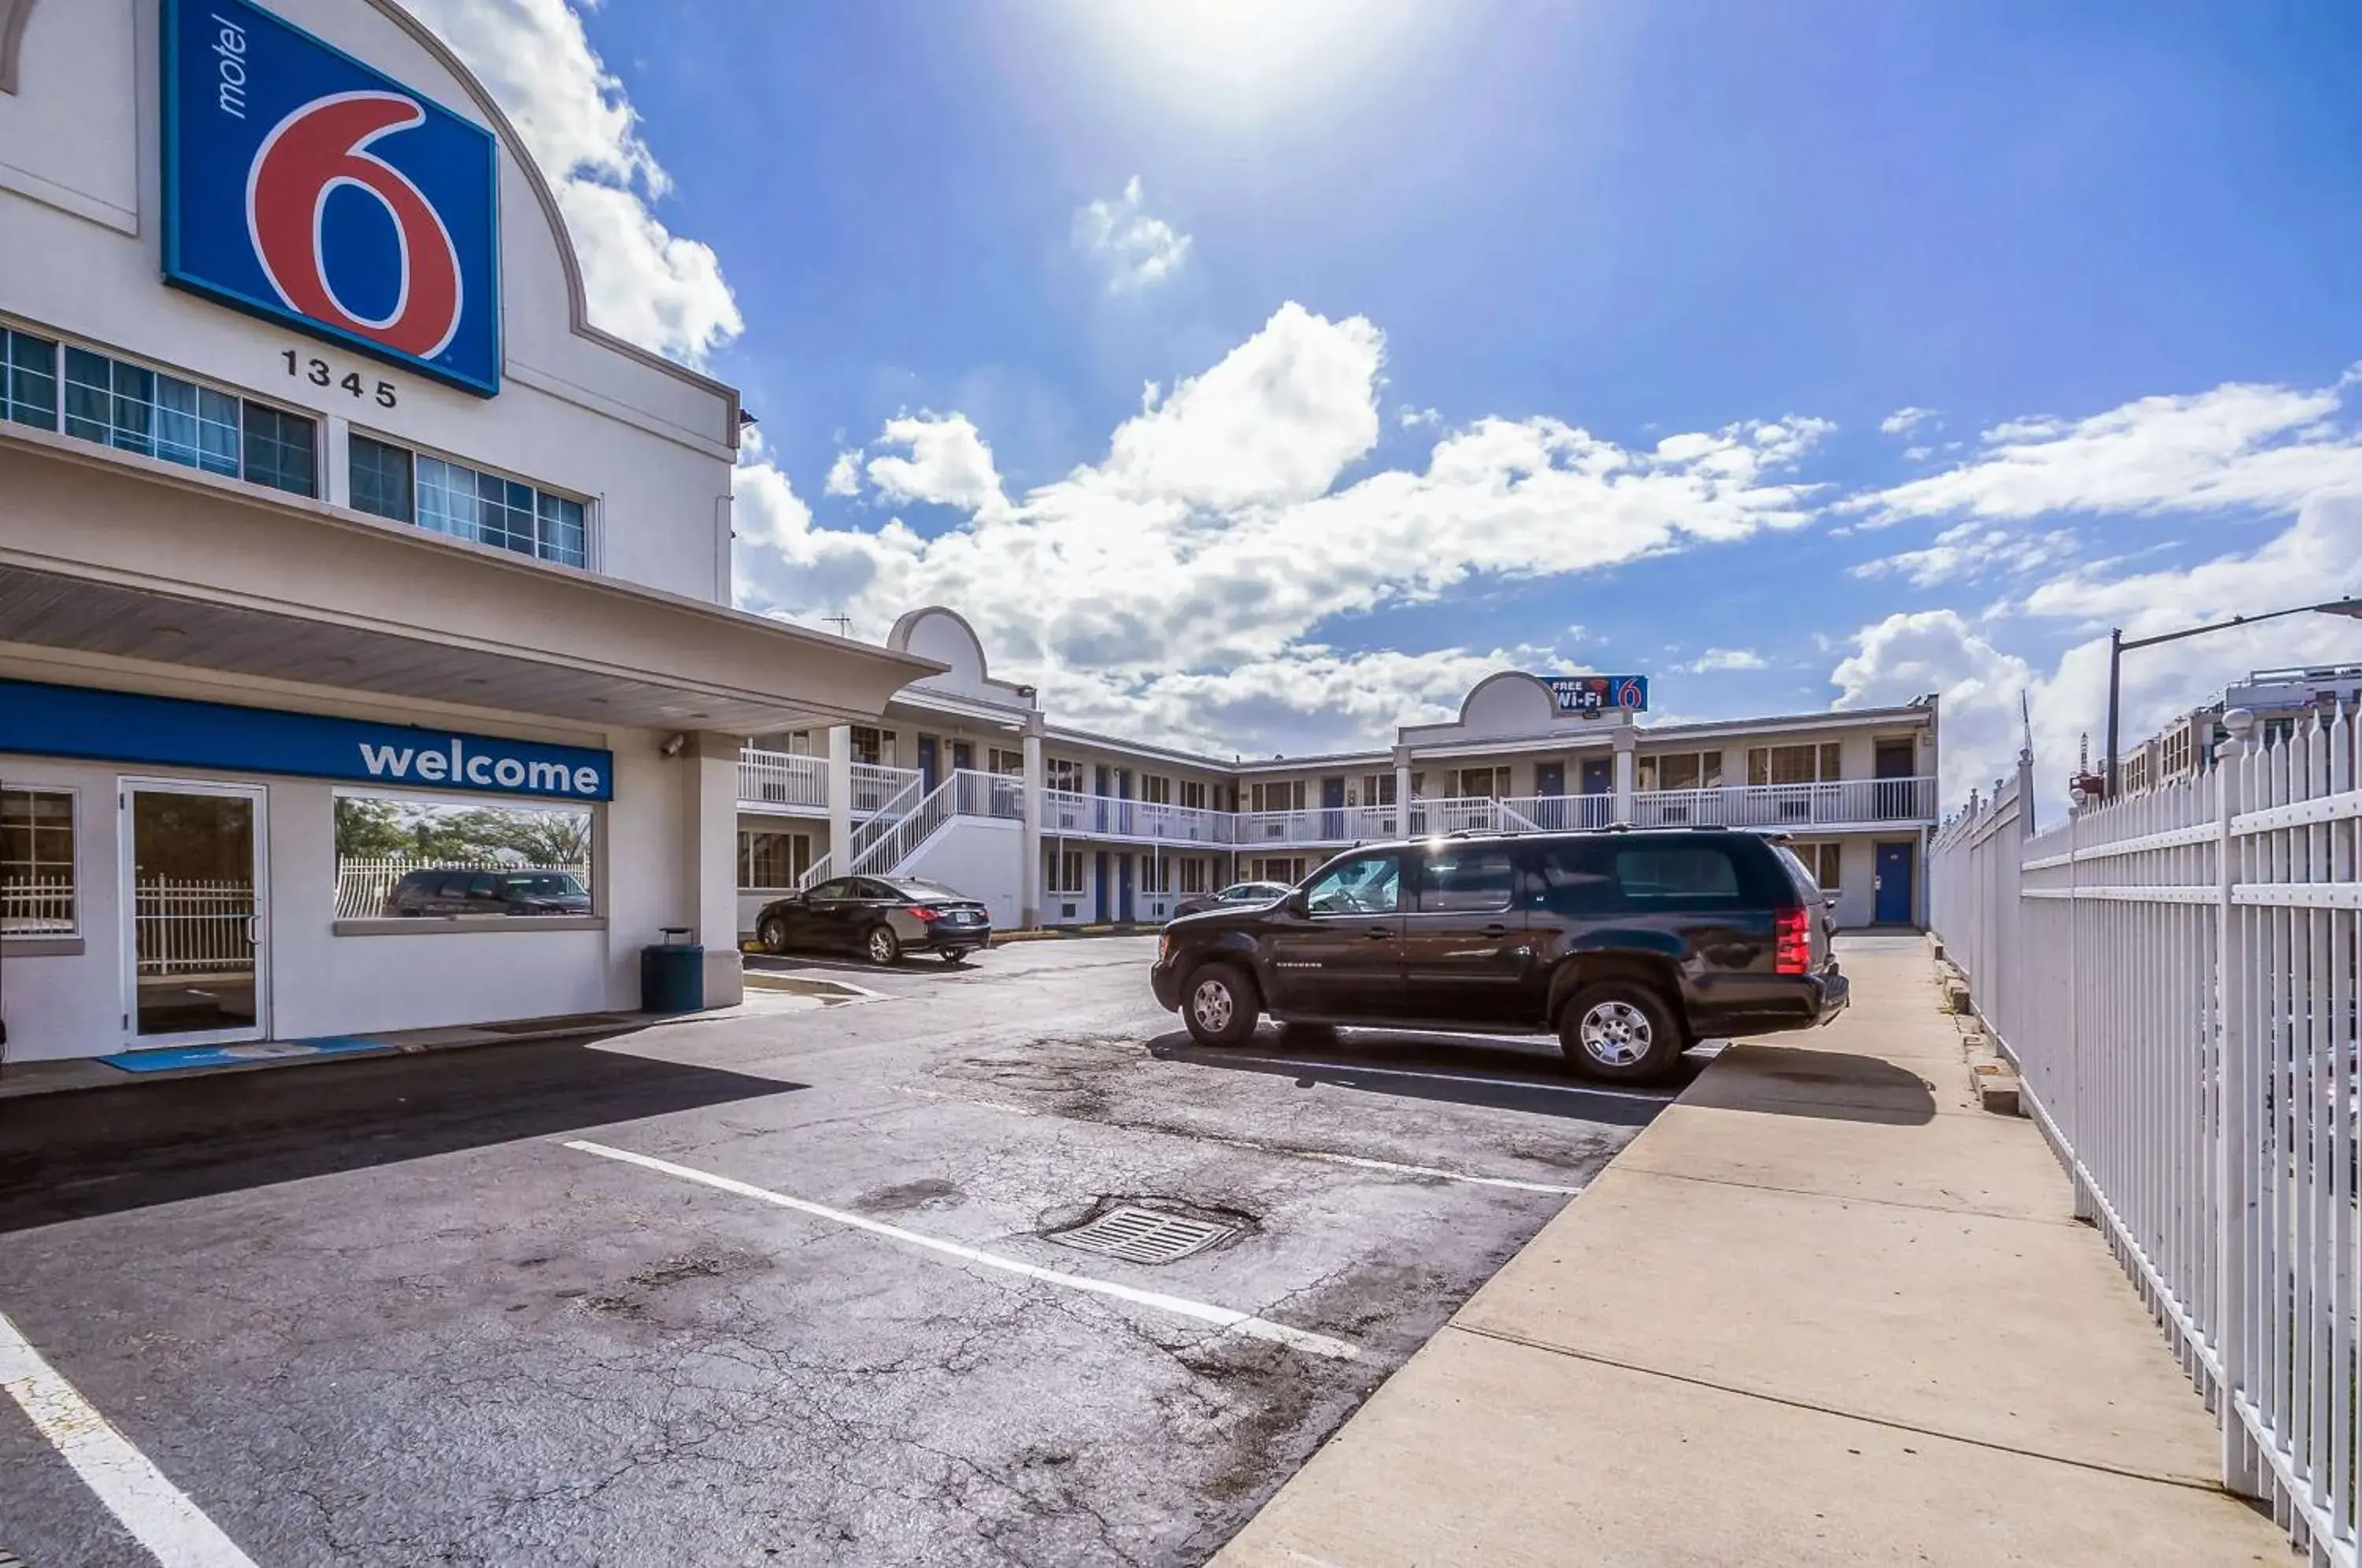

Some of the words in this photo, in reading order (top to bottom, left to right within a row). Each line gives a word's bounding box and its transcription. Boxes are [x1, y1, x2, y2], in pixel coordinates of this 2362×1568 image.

[210, 13, 246, 120] motel
[246, 91, 463, 361] 6
[281, 349, 396, 409] 1345
[1552, 681, 1583, 691] FREE
[1617, 678, 1642, 708] 6
[359, 738, 599, 794] welcome
